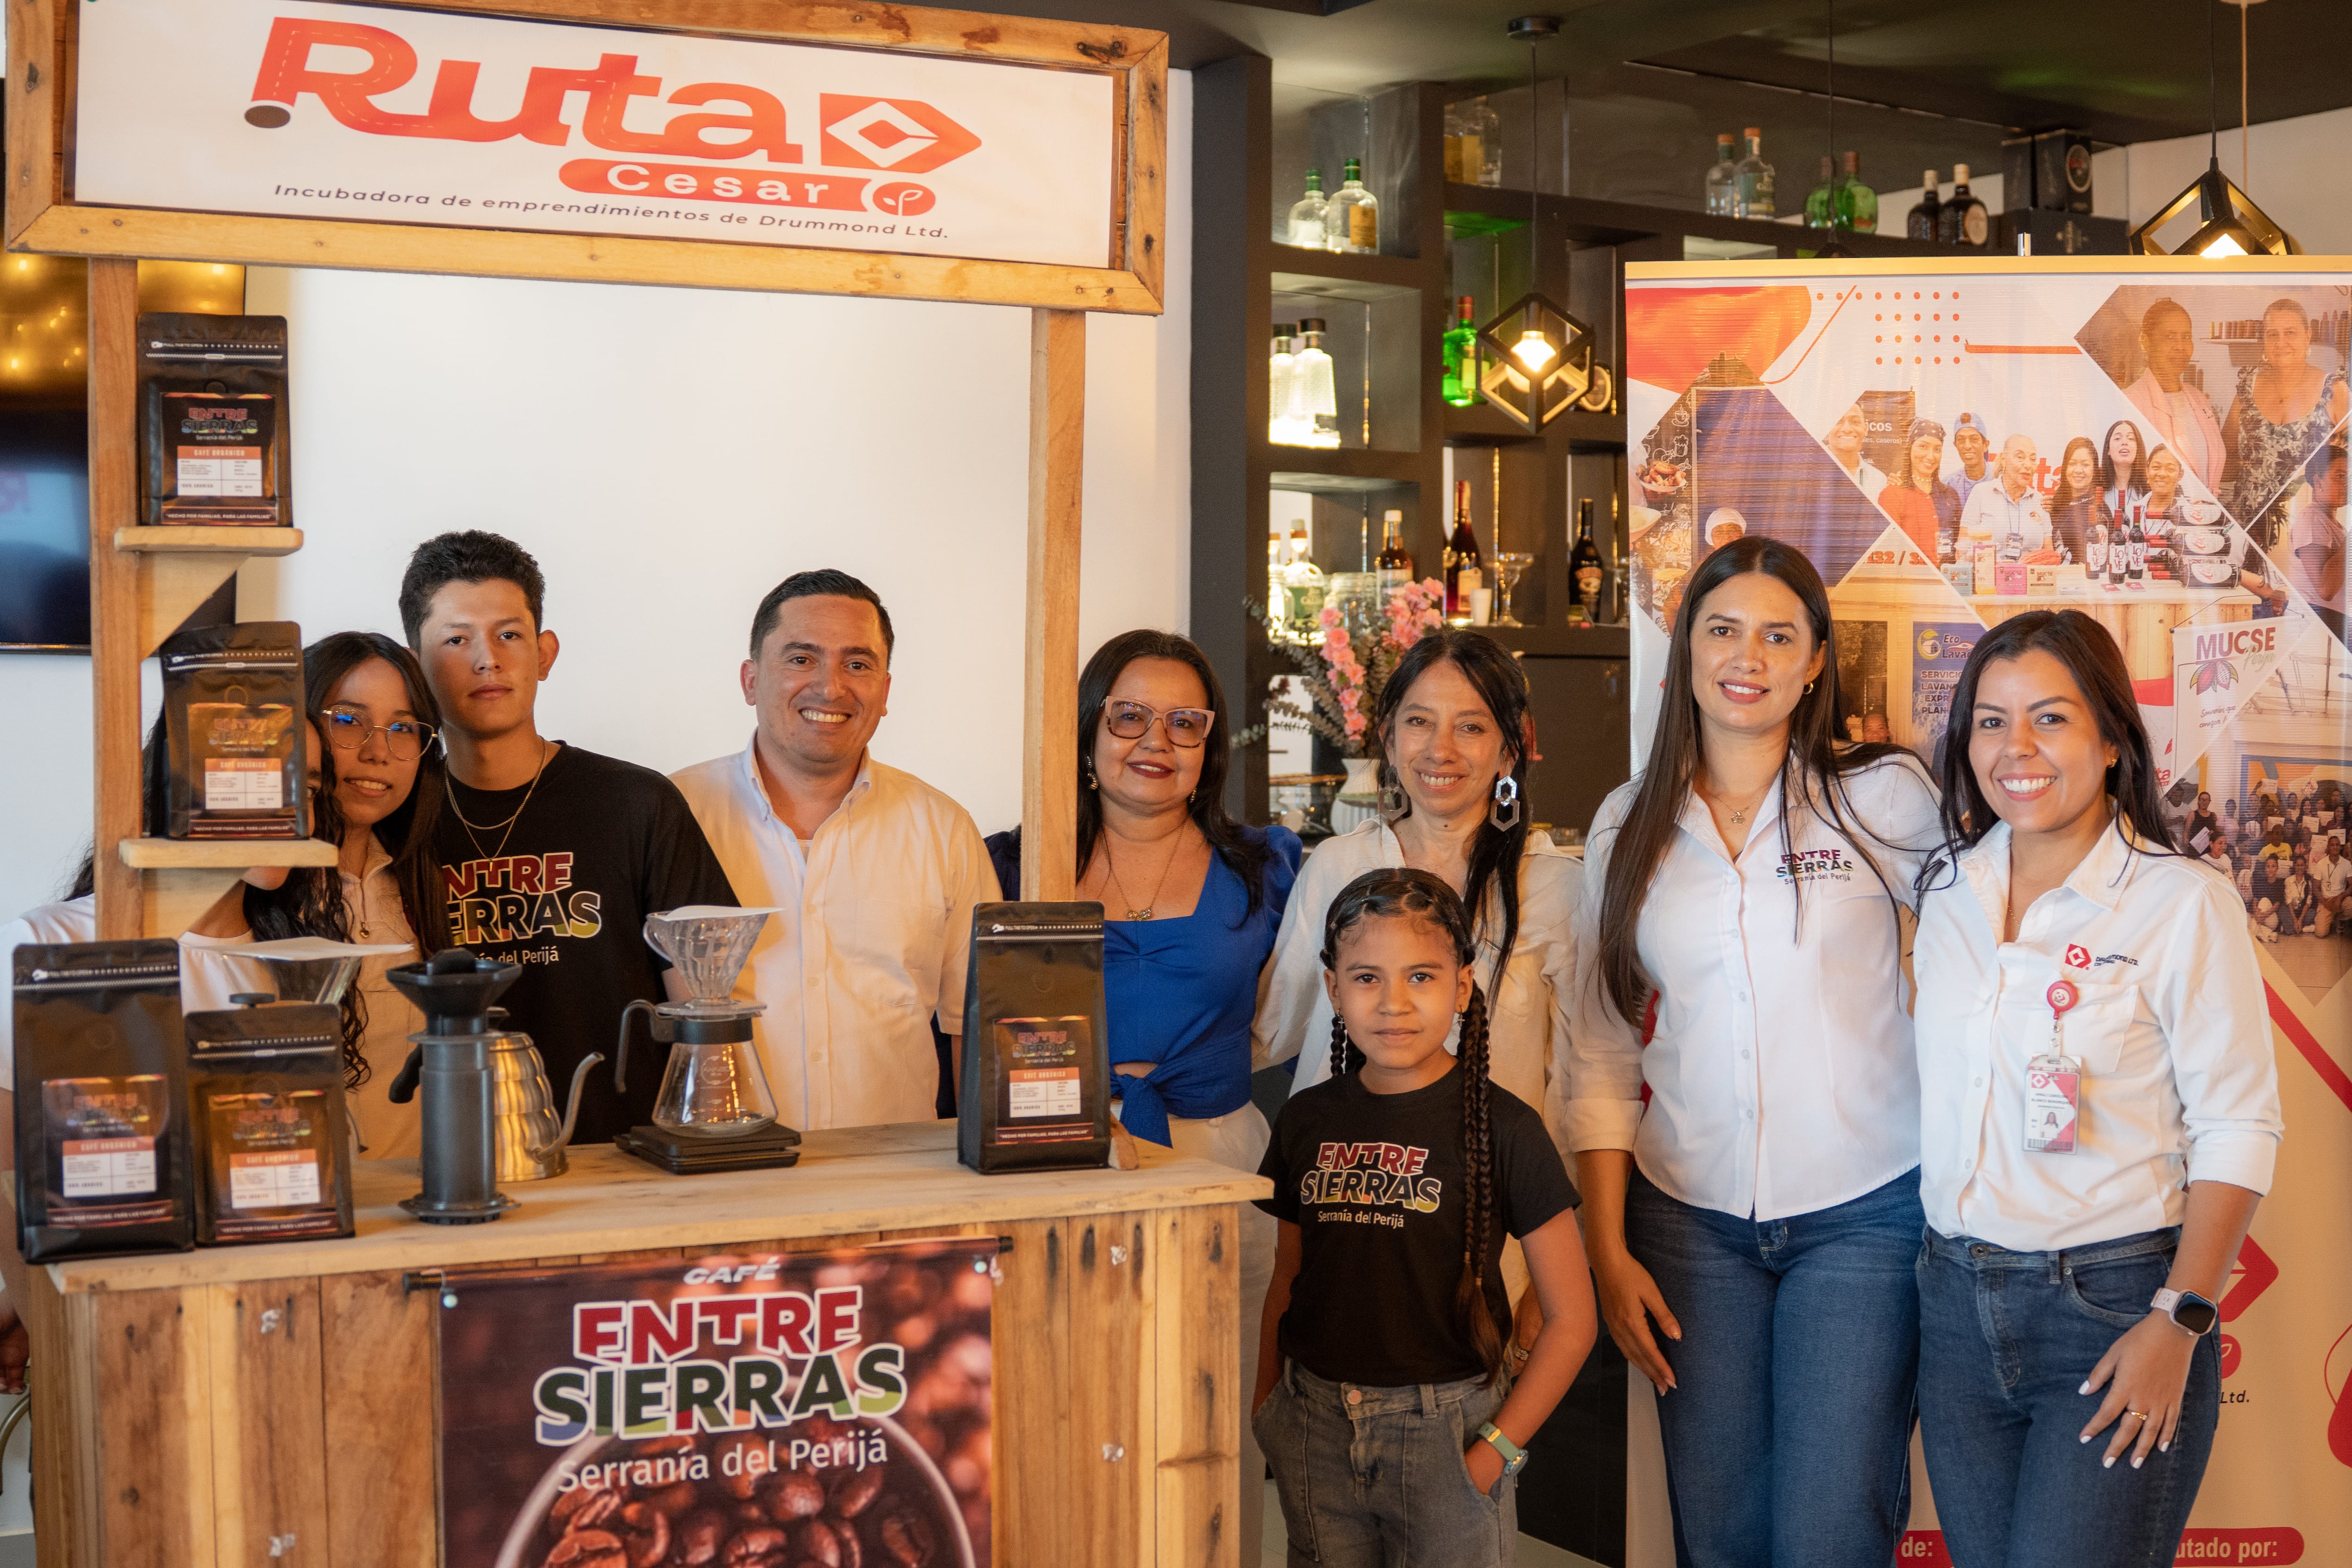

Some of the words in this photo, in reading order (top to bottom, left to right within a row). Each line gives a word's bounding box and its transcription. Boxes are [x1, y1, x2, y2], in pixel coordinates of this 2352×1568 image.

[249, 16, 803, 164] Ruta
[607, 164, 829, 204] Cesar
[274, 185, 430, 205] Incubadora
[441, 195, 472, 207] de
[483, 198, 710, 221] emprendimientos
[720, 212, 748, 224] de
[759, 215, 896, 234] Drummond
[906, 225, 949, 239] Ltd.
[181, 419, 258, 434] SIERRAS
[189, 407, 248, 421] ENTRE
[1866, 419, 1892, 431] icos
[1943, 634, 1959, 643] Eco
[2196, 627, 2276, 660] MUCSE
[1776, 860, 1853, 878] SIERRAS
[1780, 849, 1842, 864] ENTRE
[442, 852, 573, 901] NTRE
[1831, 872, 1851, 882] Perijá
[447, 891, 602, 946] ERRAS
[499, 950, 517, 963] del
[522, 946, 559, 964] Perijá
[1316, 1142, 1429, 1176] ENTRE
[1301, 1170, 1442, 1213] SIERRAS
[1318, 1209, 1352, 1223] Serranía
[1355, 1211, 1371, 1224] del
[1374, 1212, 1404, 1229] Perijá
[683, 1256, 781, 1285] CAFÉ
[573, 1285, 862, 1366] ENTRE
[533, 1343, 908, 1447] SIERRAS
[2220, 1390, 2249, 1404] Ltd.
[557, 1444, 709, 1493] Serranía
[722, 1440, 777, 1477] del
[790, 1429, 888, 1473] Perijá
[1901, 1536, 1933, 1557] de:
[2176, 1536, 2232, 1558] utado
[2238, 1541, 2278, 1563] por:
